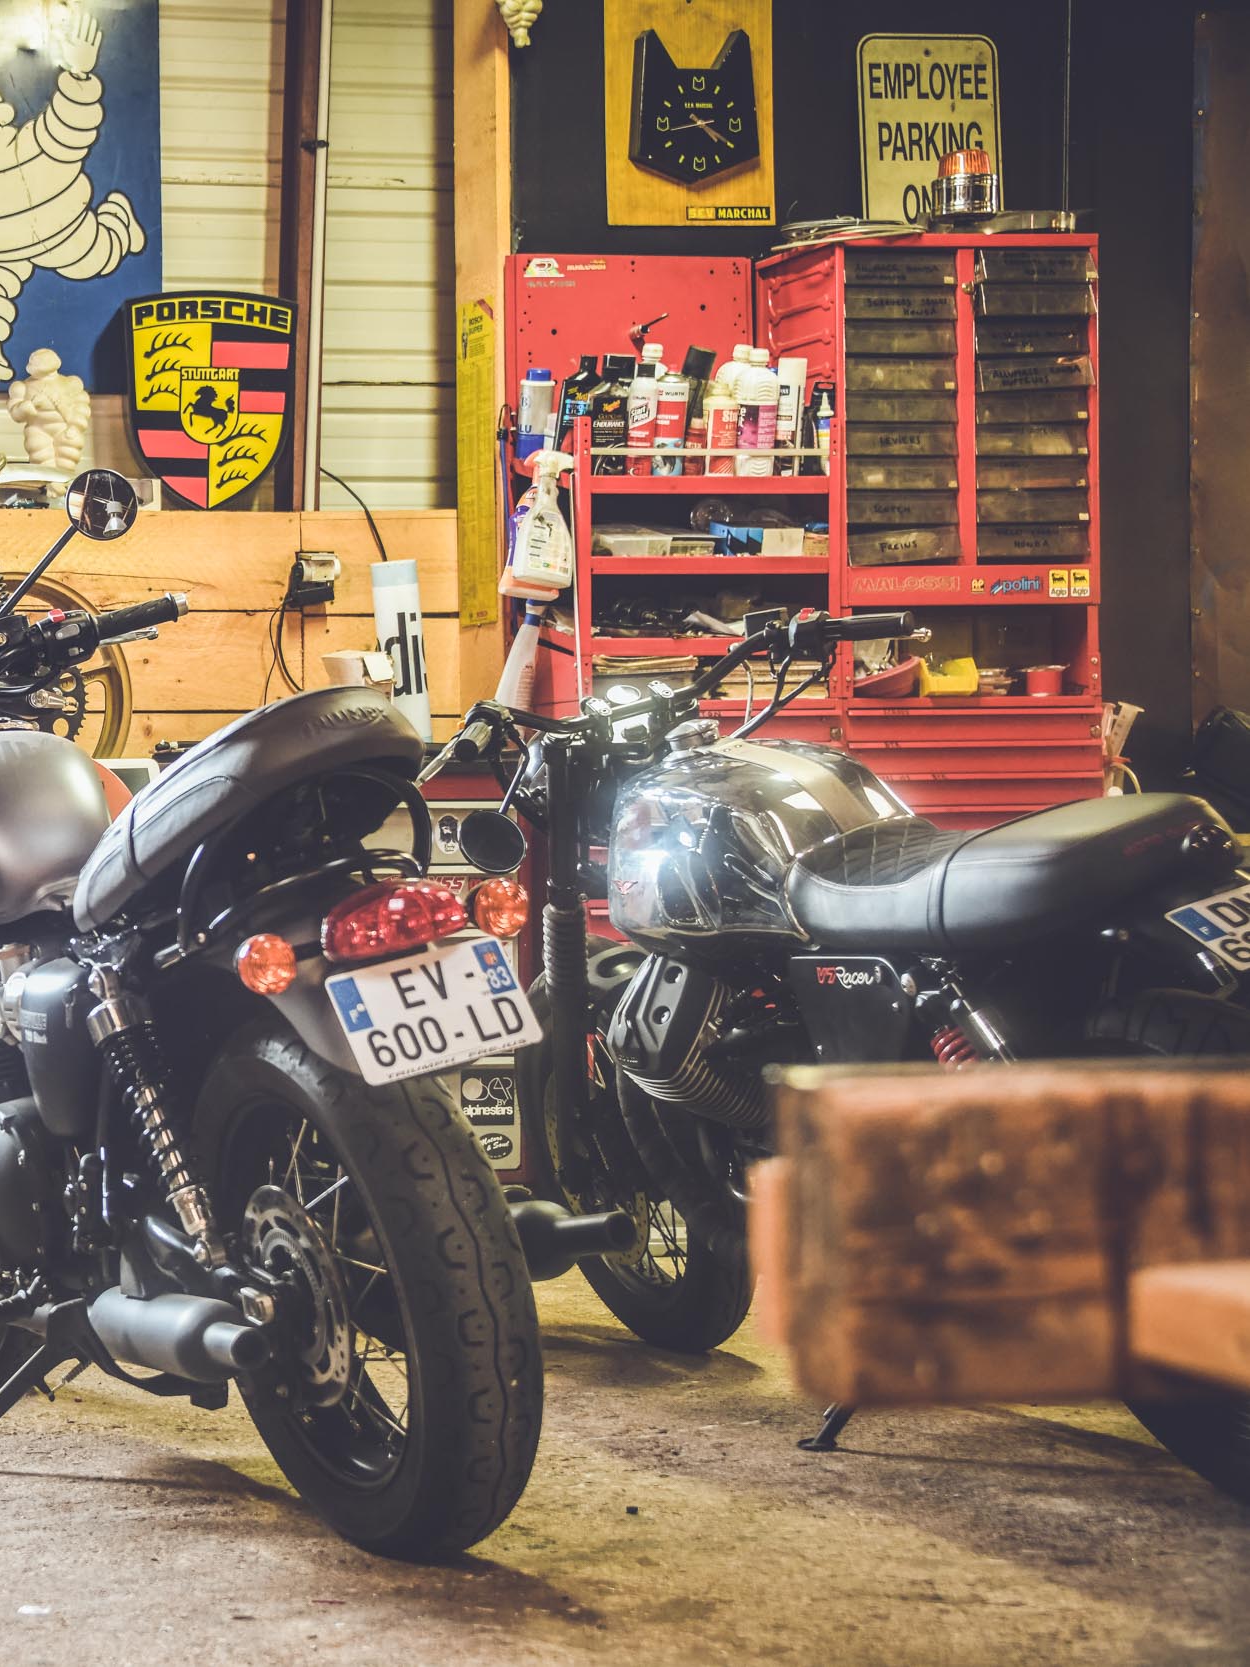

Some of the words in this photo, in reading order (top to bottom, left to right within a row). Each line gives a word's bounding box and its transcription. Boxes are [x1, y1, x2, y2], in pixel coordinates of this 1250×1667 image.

[868, 63, 988, 100] EMPLOYEE
[878, 121, 983, 161] PARKING
[717, 207, 768, 219] MARCHAL
[903, 184, 934, 224] ON
[134, 300, 291, 331] PORSCHE
[181, 368, 240, 381] STUTTGART
[1002, 576, 1041, 593] polini
[390, 960, 449, 1010] EV
[486, 965, 511, 989] 83
[462, 1105, 514, 1118] alpinestars
[496, 1099, 508, 1107] BY
